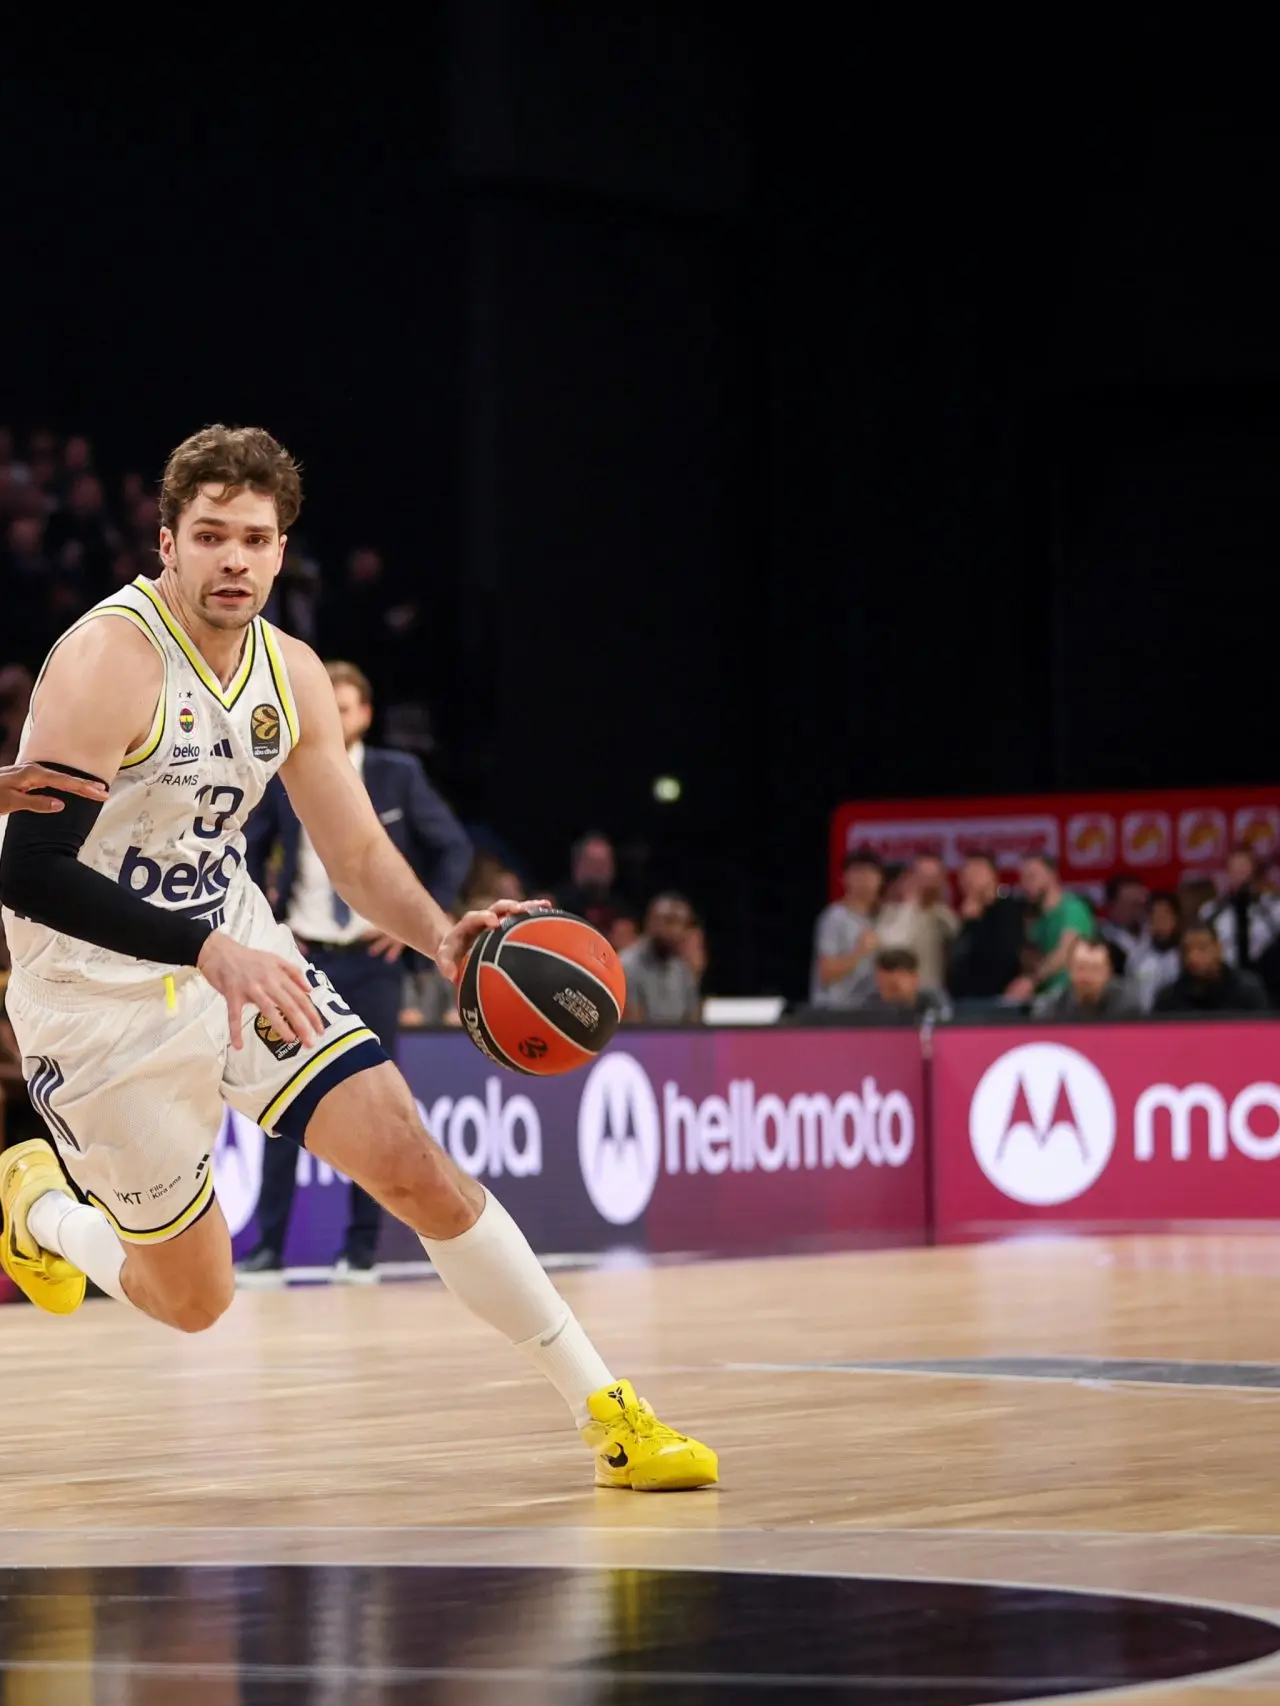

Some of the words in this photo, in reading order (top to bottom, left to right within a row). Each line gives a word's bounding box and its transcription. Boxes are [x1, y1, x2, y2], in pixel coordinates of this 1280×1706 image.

[161, 774, 199, 786] RAMS
[173, 744, 200, 758] beko
[118, 845, 241, 903] beko
[663, 1075, 915, 1176] hellomoto
[1133, 1080, 1280, 1162] mo
